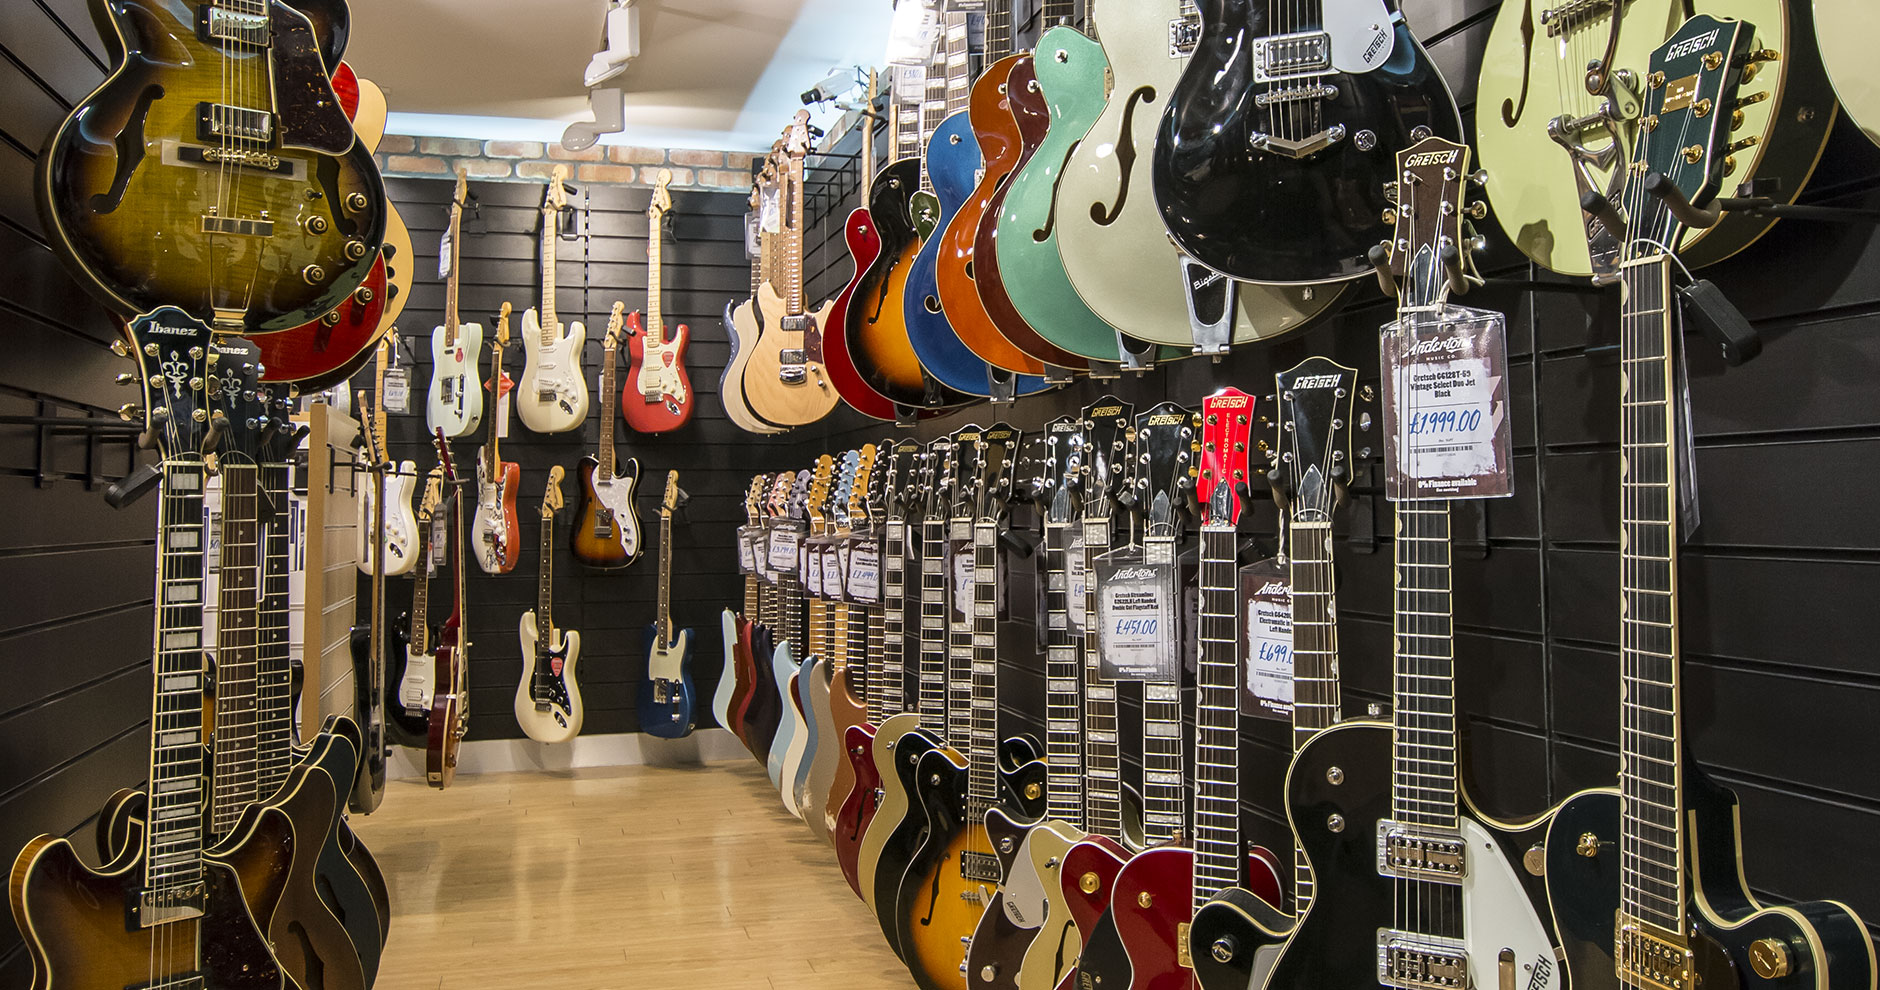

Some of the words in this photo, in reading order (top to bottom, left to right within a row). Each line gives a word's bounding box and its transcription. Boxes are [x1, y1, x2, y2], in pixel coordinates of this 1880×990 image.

[1362, 28, 1388, 64] GRETSCH
[1665, 28, 1720, 62] GRETSCH
[1404, 150, 1458, 168] GRETSCH
[1193, 271, 1222, 290] Bigsb
[148, 321, 198, 337] Ibanez
[1292, 374, 1342, 390] GRETSCH
[1410, 382, 1433, 392] Vintage
[1433, 380, 1452, 390] Select
[1453, 379, 1465, 388] Duo
[1465, 378, 1476, 387] Jet
[1413, 374, 1436, 382] Gretsch
[1434, 389, 1451, 398] Black
[1210, 395, 1249, 409] GRETSCH
[1091, 405, 1123, 418] GRETSCH
[1147, 414, 1186, 427] GRETSCH
[1410, 408, 1482, 435] £1,999.00
[1221, 412, 1231, 474] ELECTROMATIC
[1108, 567, 1158, 582] Andertons
[1254, 581, 1292, 598] Andert
